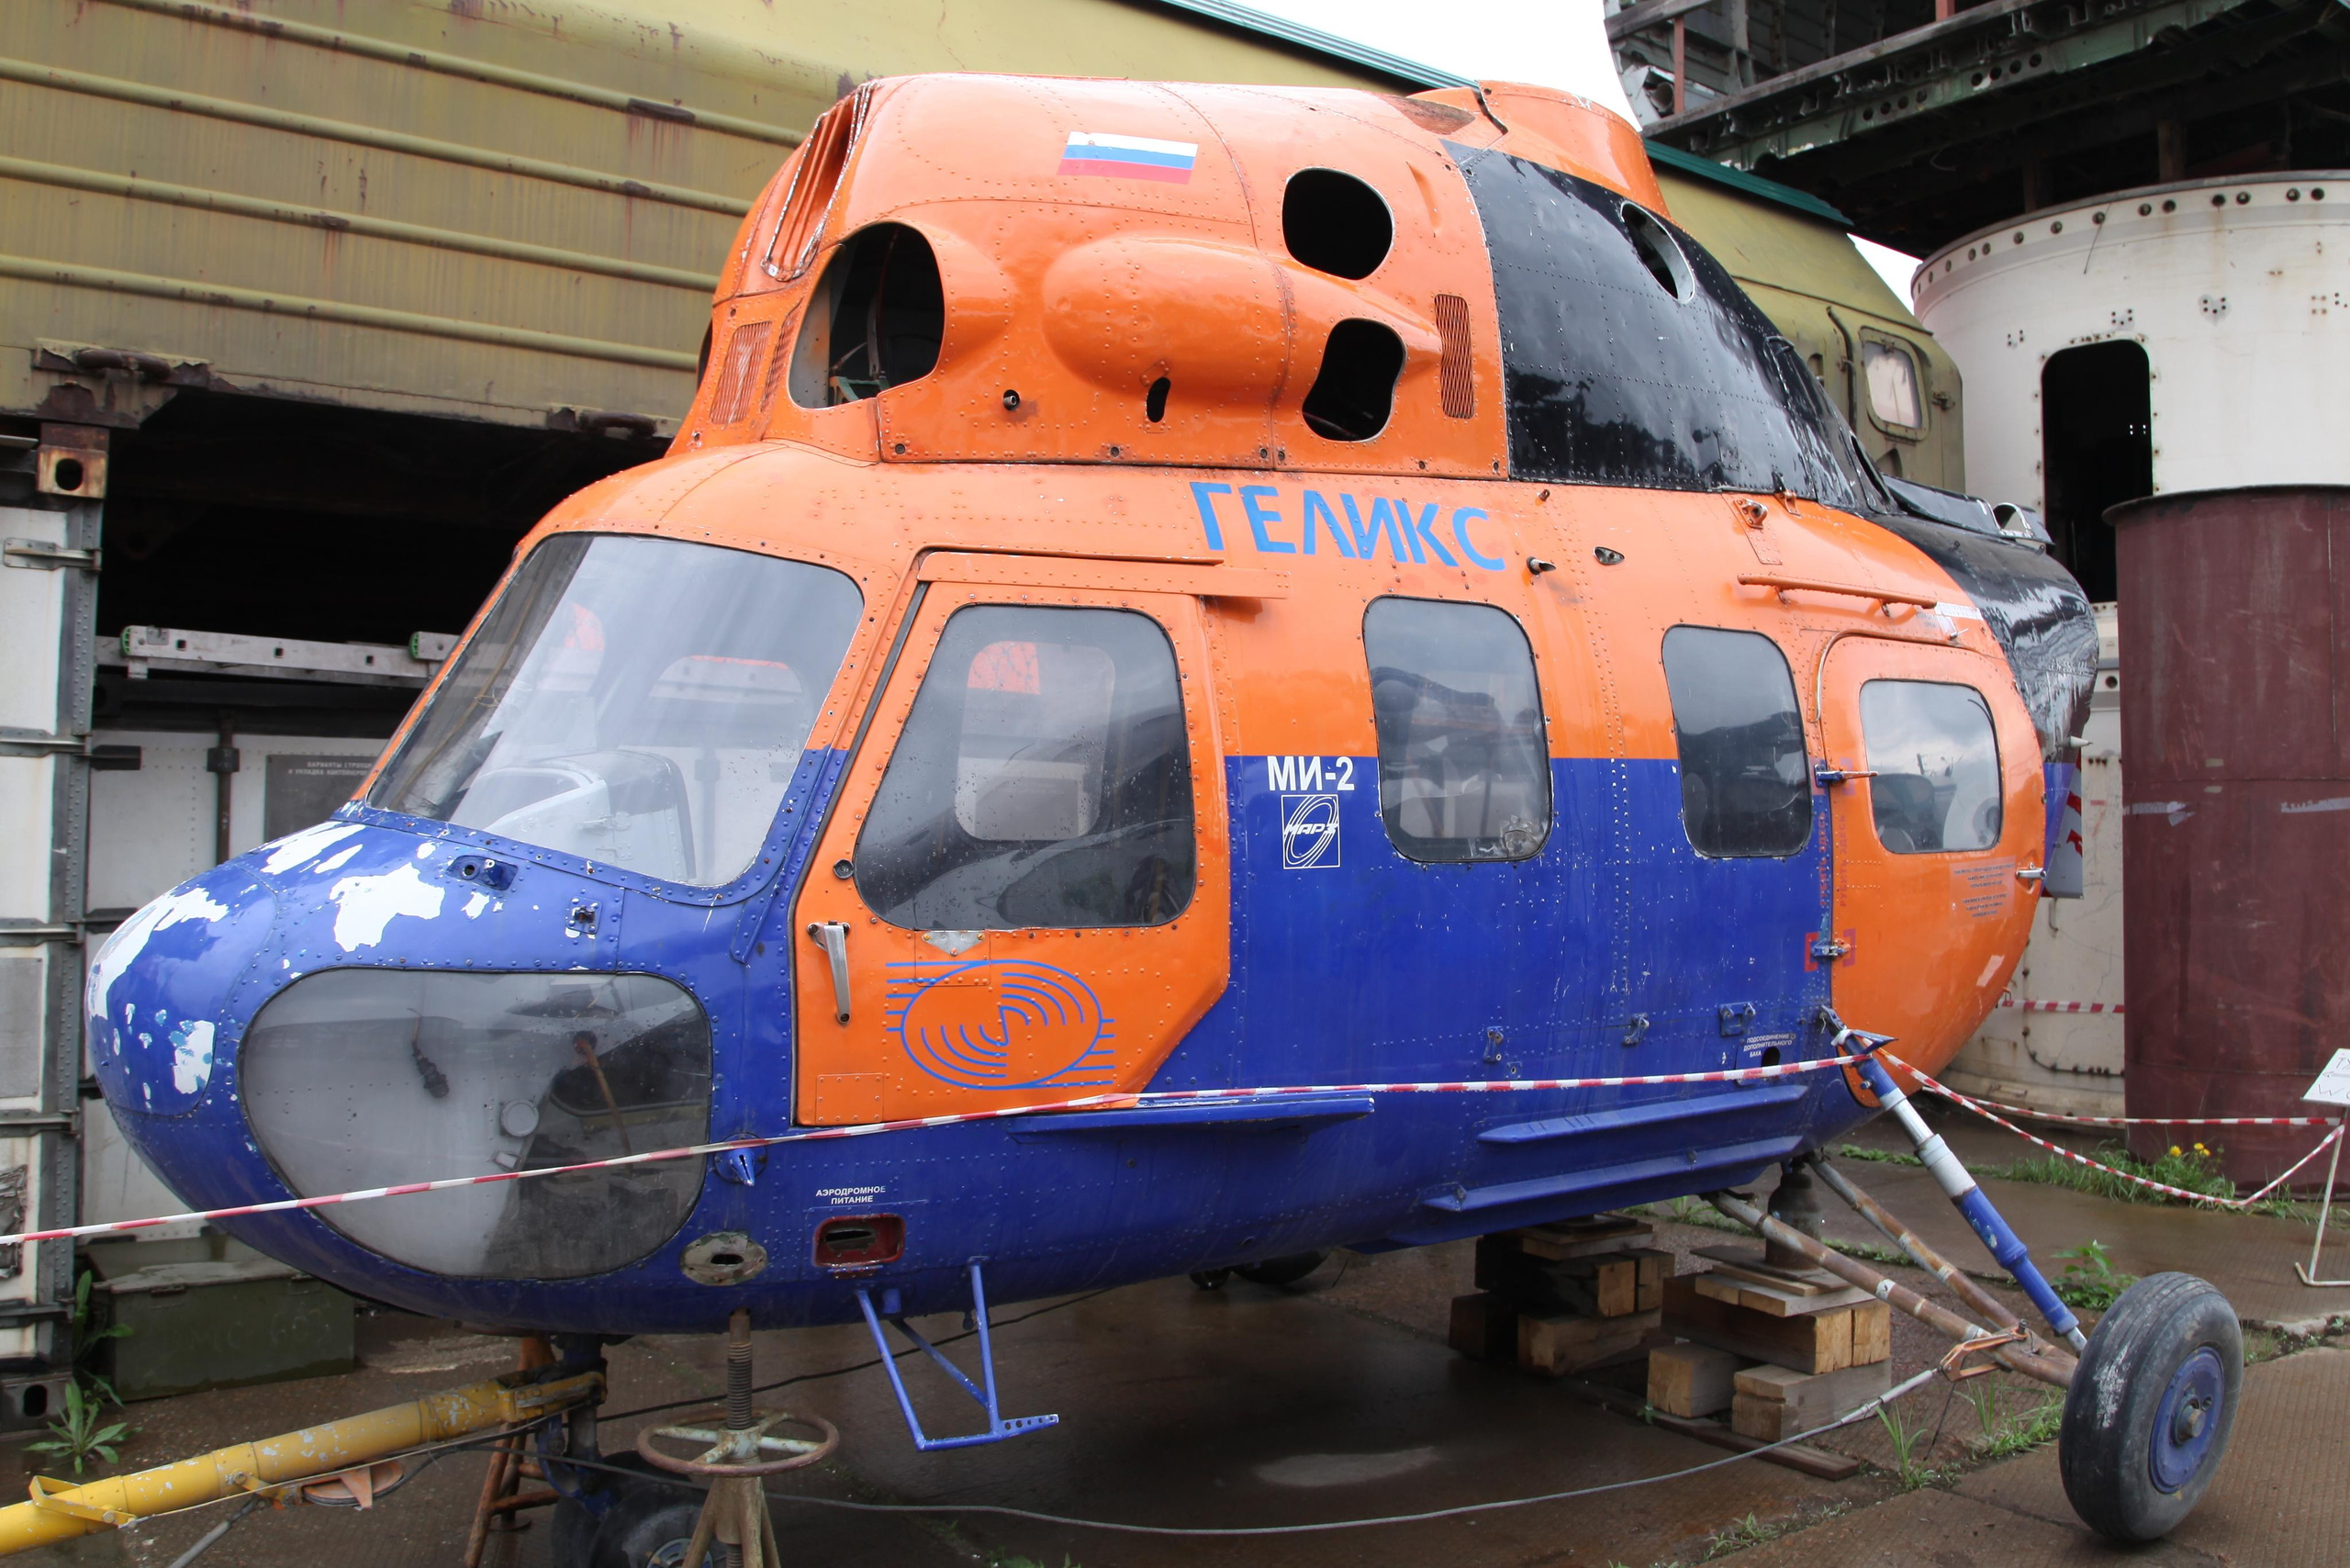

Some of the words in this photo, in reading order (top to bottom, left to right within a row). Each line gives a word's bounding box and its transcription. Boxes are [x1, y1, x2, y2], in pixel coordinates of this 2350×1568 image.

[1190, 481, 1505, 571] ГЕЛИКС
[1267, 756, 1355, 791] МИ-2
[1839, 814, 1848, 854] ЗДЕСЬ
[1839, 859, 1848, 907] РУБИТЬ
[1743, 1039, 1793, 1052] ДОПОЛНИТЕЛЬНОГО
[1746, 1033, 1789, 1044] ПОДСОЕДИНЕНИЕ
[816, 1185, 886, 1197] АЭРОДРОМНОЕ
[831, 1195, 874, 1204] ПИТАНИЕ
